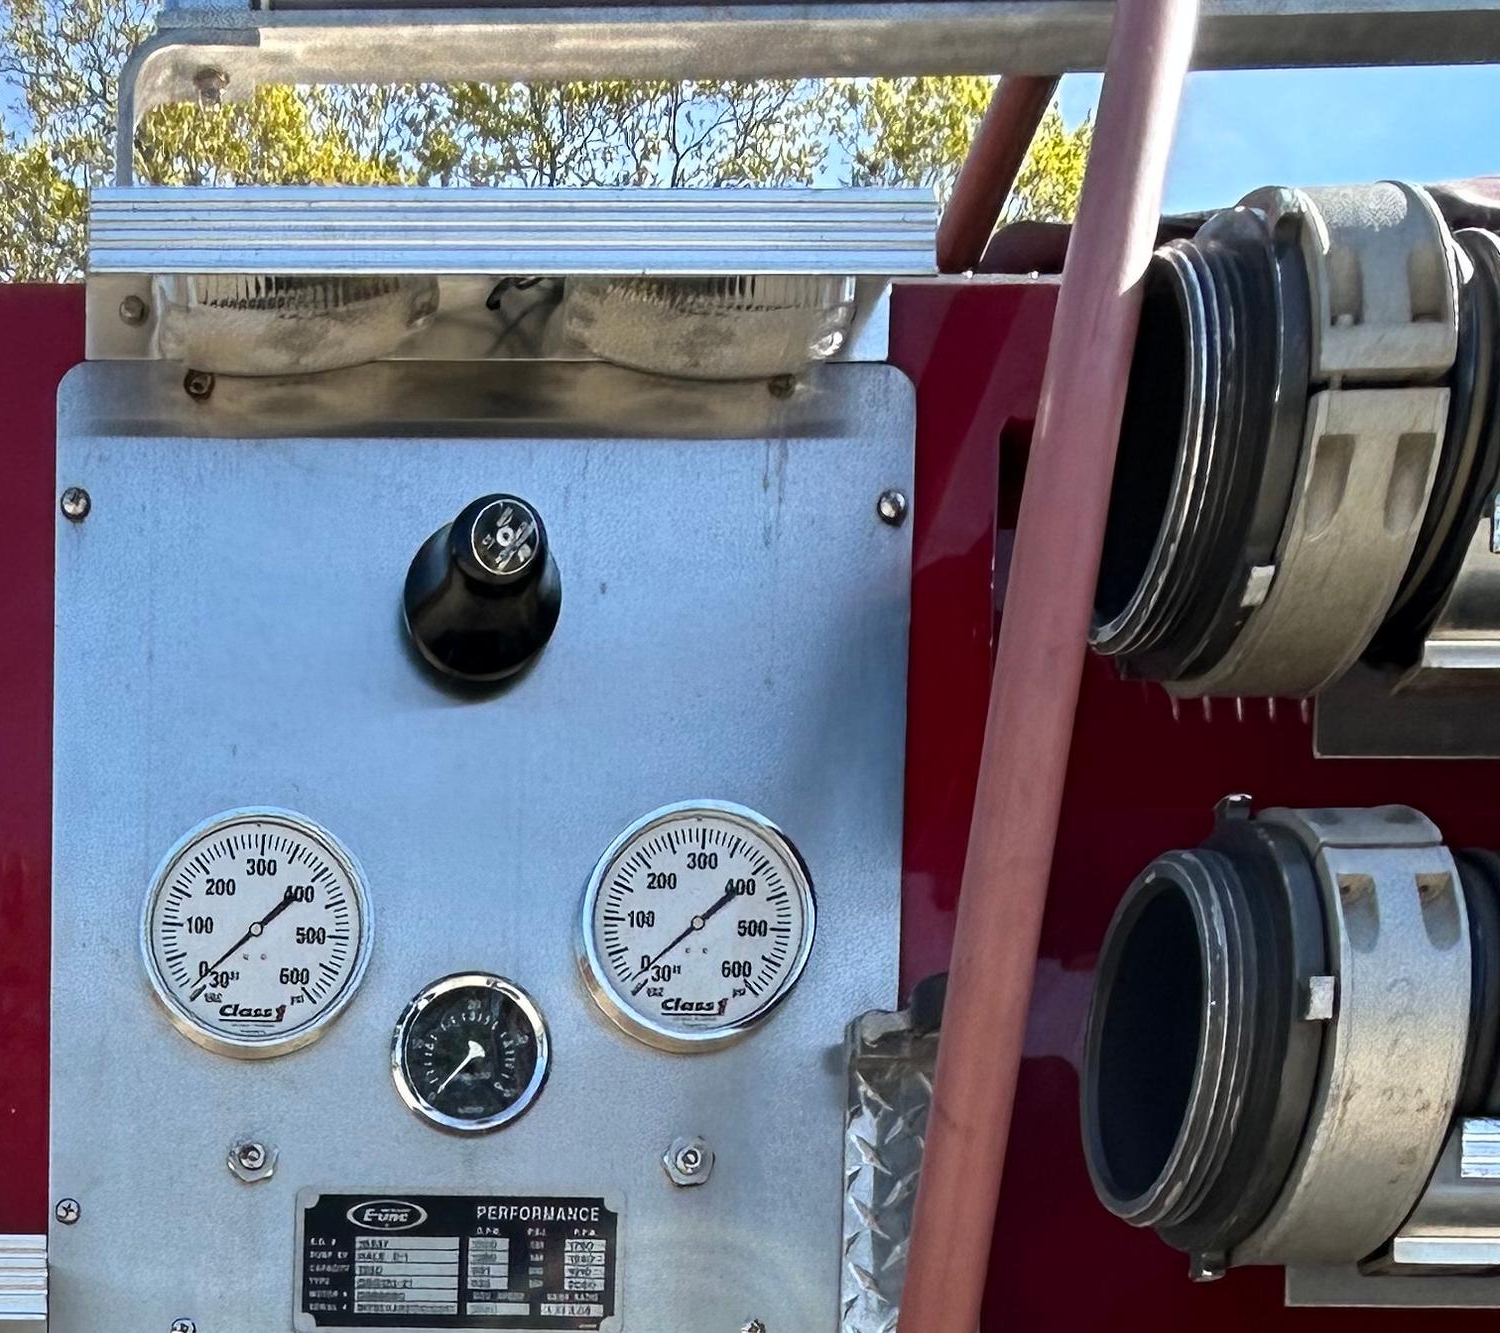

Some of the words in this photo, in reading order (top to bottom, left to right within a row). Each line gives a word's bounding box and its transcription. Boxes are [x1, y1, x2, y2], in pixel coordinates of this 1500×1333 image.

[246, 859, 277, 876] 300
[687, 853, 718, 869] 300
[206, 879, 236, 895] 200
[647, 873, 677, 889] 200
[725, 879, 755, 895] 400
[284, 886, 314, 902] 400
[187, 917, 214, 934] 100
[628, 911, 655, 927] 100
[296, 928, 326, 945] 500
[738, 920, 768, 937] 500
[280, 968, 309, 984] 600
[722, 961, 751, 977] 600
[477, 1206, 599, 1222] PERFORMANCE
